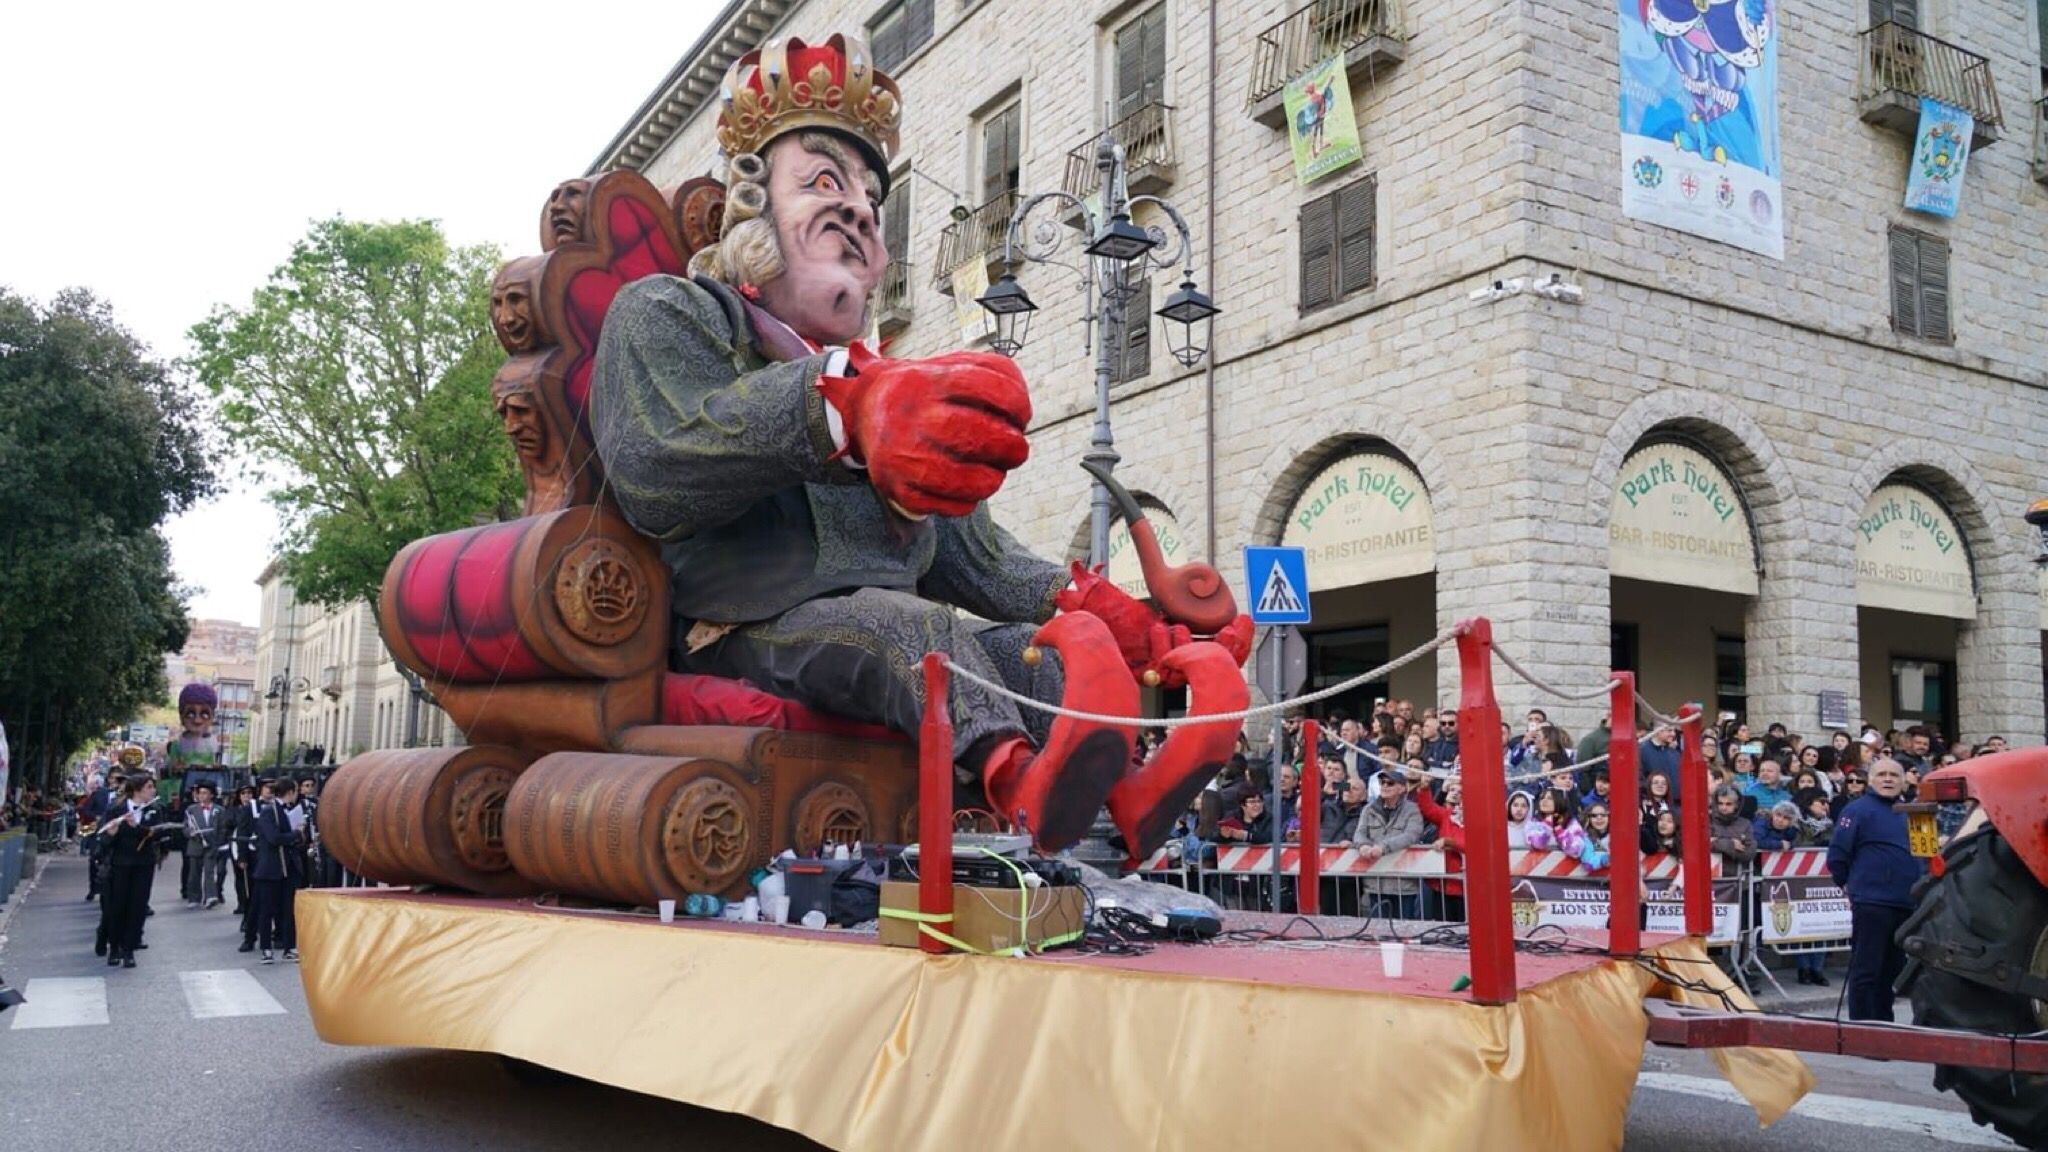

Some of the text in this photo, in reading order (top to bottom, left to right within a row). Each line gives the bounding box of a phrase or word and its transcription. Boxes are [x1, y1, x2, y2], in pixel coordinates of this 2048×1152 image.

[1306, 525, 1428, 565] R-RISTORANTE
[1563, 889, 1611, 900] ISTITUT
[1551, 904, 1586, 915] LION
[1797, 902, 1819, 914] LION
